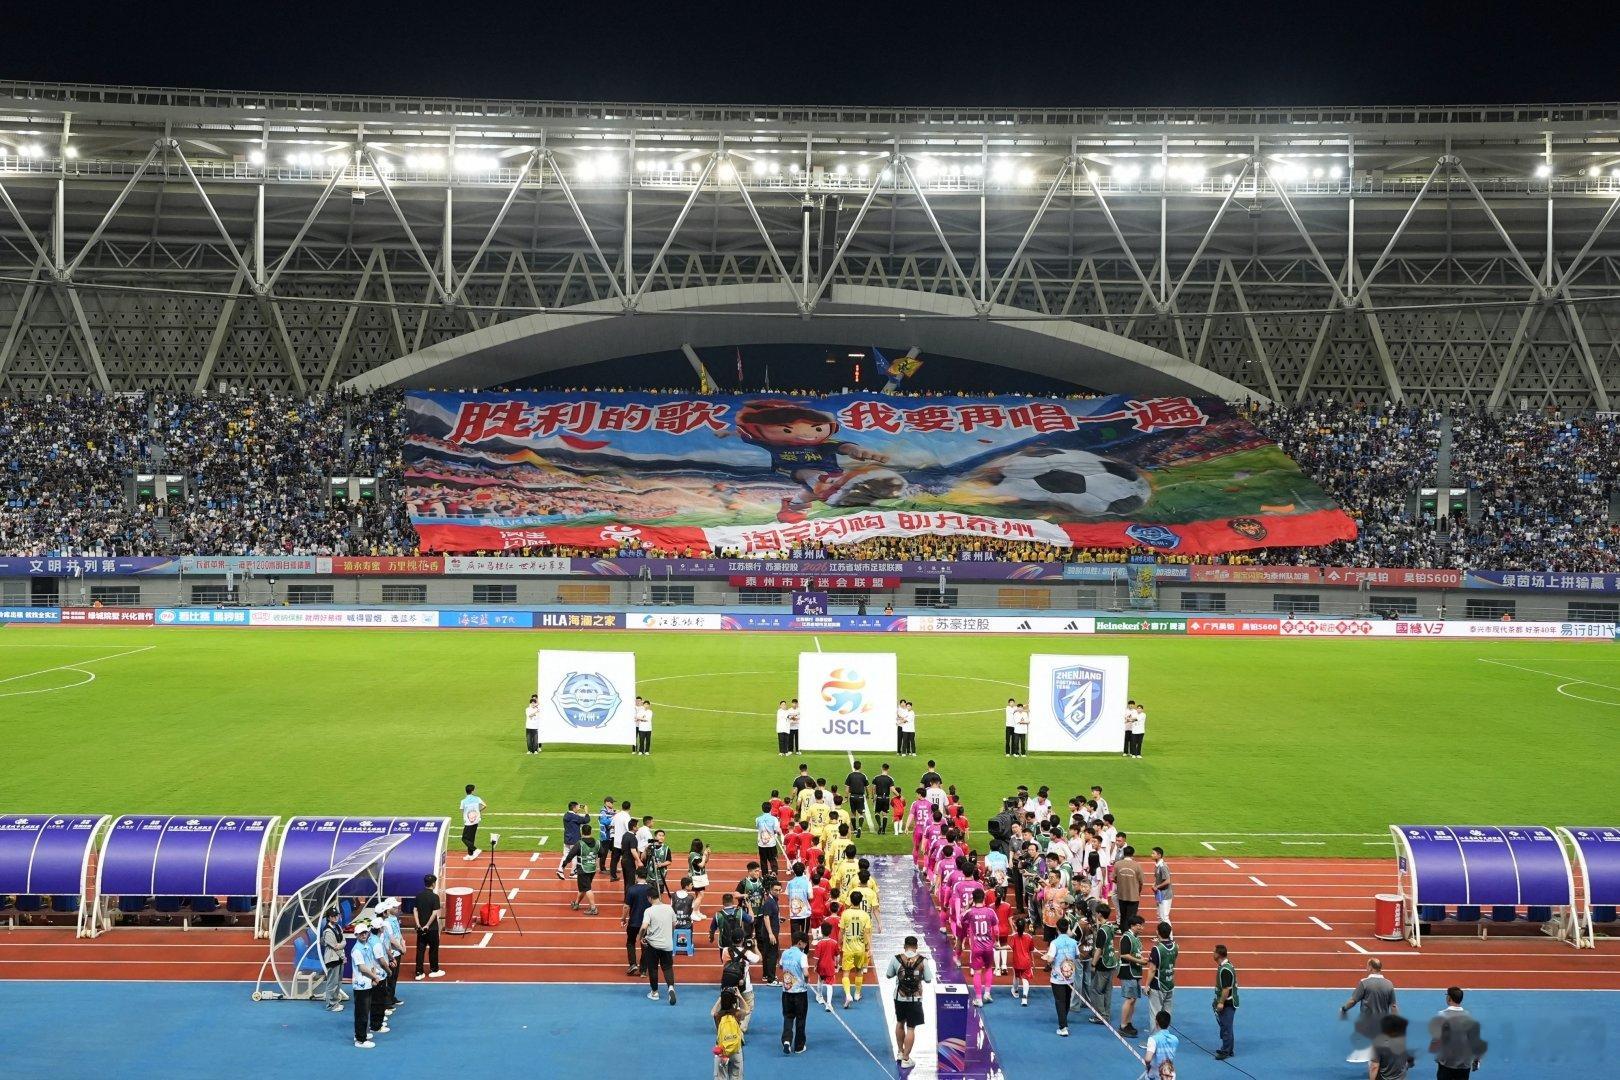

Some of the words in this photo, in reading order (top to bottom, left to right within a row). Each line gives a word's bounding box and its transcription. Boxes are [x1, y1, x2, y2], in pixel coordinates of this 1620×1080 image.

[447, 400, 733, 444] 胜利的歌
[838, 396, 1211, 434] 我要再唱一遍
[792, 550, 825, 560] 泰州队
[961, 551, 994, 561] 泰州队
[30, 559, 133, 573] 文明并列第一
[388, 559, 439, 572] 万里槐花香
[728, 562, 762, 571] 江苏银行
[765, 562, 799, 571] 苏豪控股
[829, 562, 903, 572] 江苏省城市足球联赛
[745, 576, 884, 588] 泰州市球迷会联盟
[1403, 572, 1457, 584] 昊铂S600
[1501, 574, 1605, 590] 绿茵场上拼输赢
[458, 612, 489, 626] 海之蓝
[936, 618, 990, 631] 苏豪控股
[1096, 621, 1139, 631] Heineken
[1560, 623, 1615, 637] 易行时代
[1055, 670, 1102, 681] ZHENJIANG
[821, 719, 871, 736] JSCL
[917, 808, 929, 820] 35
[850, 922, 861, 936] 11
[974, 921, 988, 935] 10
